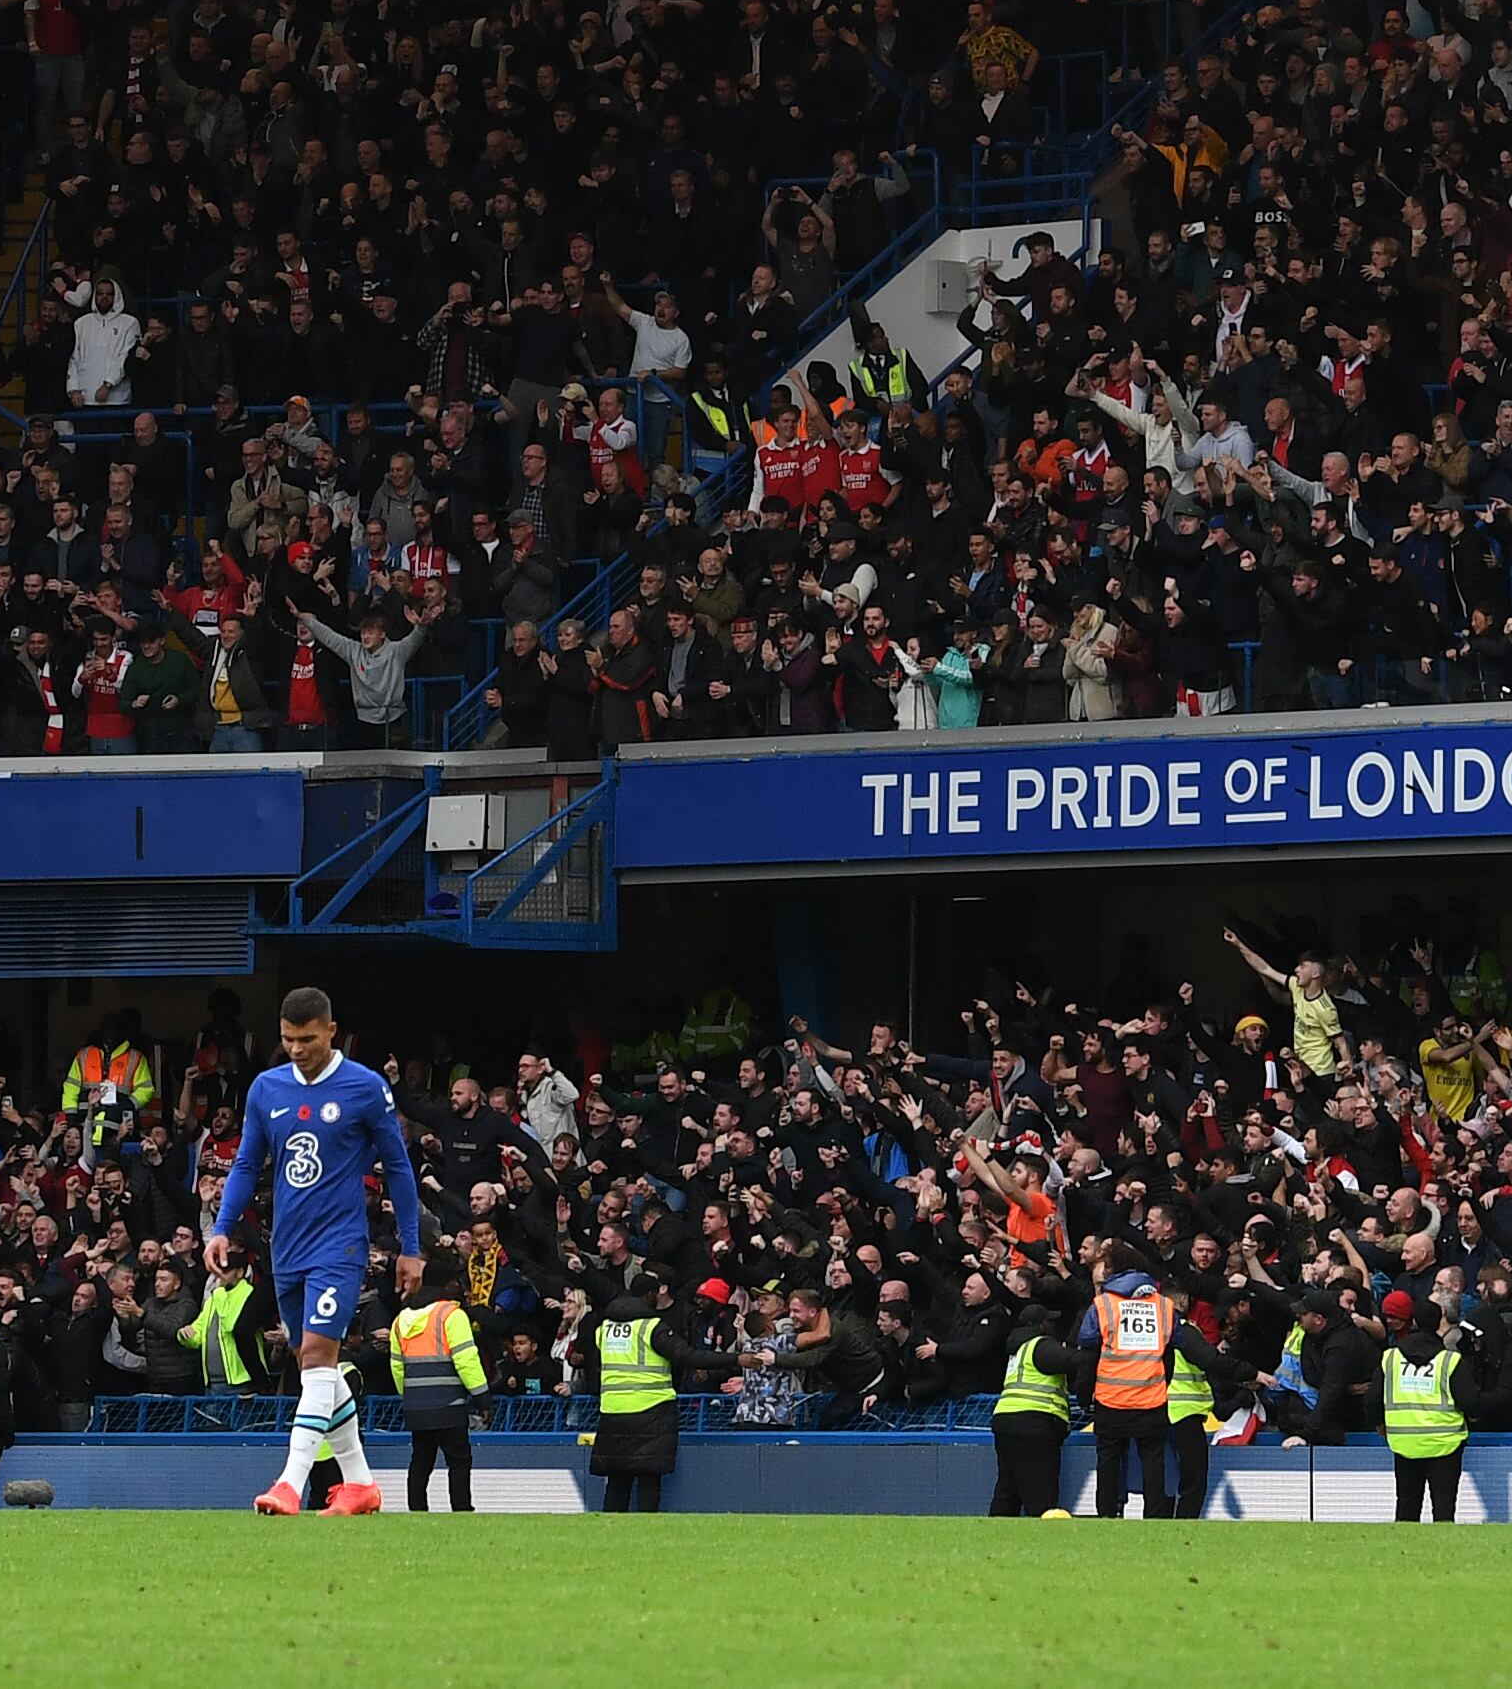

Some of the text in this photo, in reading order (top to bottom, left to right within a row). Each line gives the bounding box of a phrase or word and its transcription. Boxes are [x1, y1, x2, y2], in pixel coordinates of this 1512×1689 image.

[861, 769, 981, 837] THE
[1006, 760, 1202, 833] PRIDE
[1224, 756, 1287, 806] OF
[285, 1131, 323, 1188] 3
[316, 1286, 337, 1318] 6
[605, 1323, 632, 1338] 769
[1119, 1316, 1156, 1334] 165
